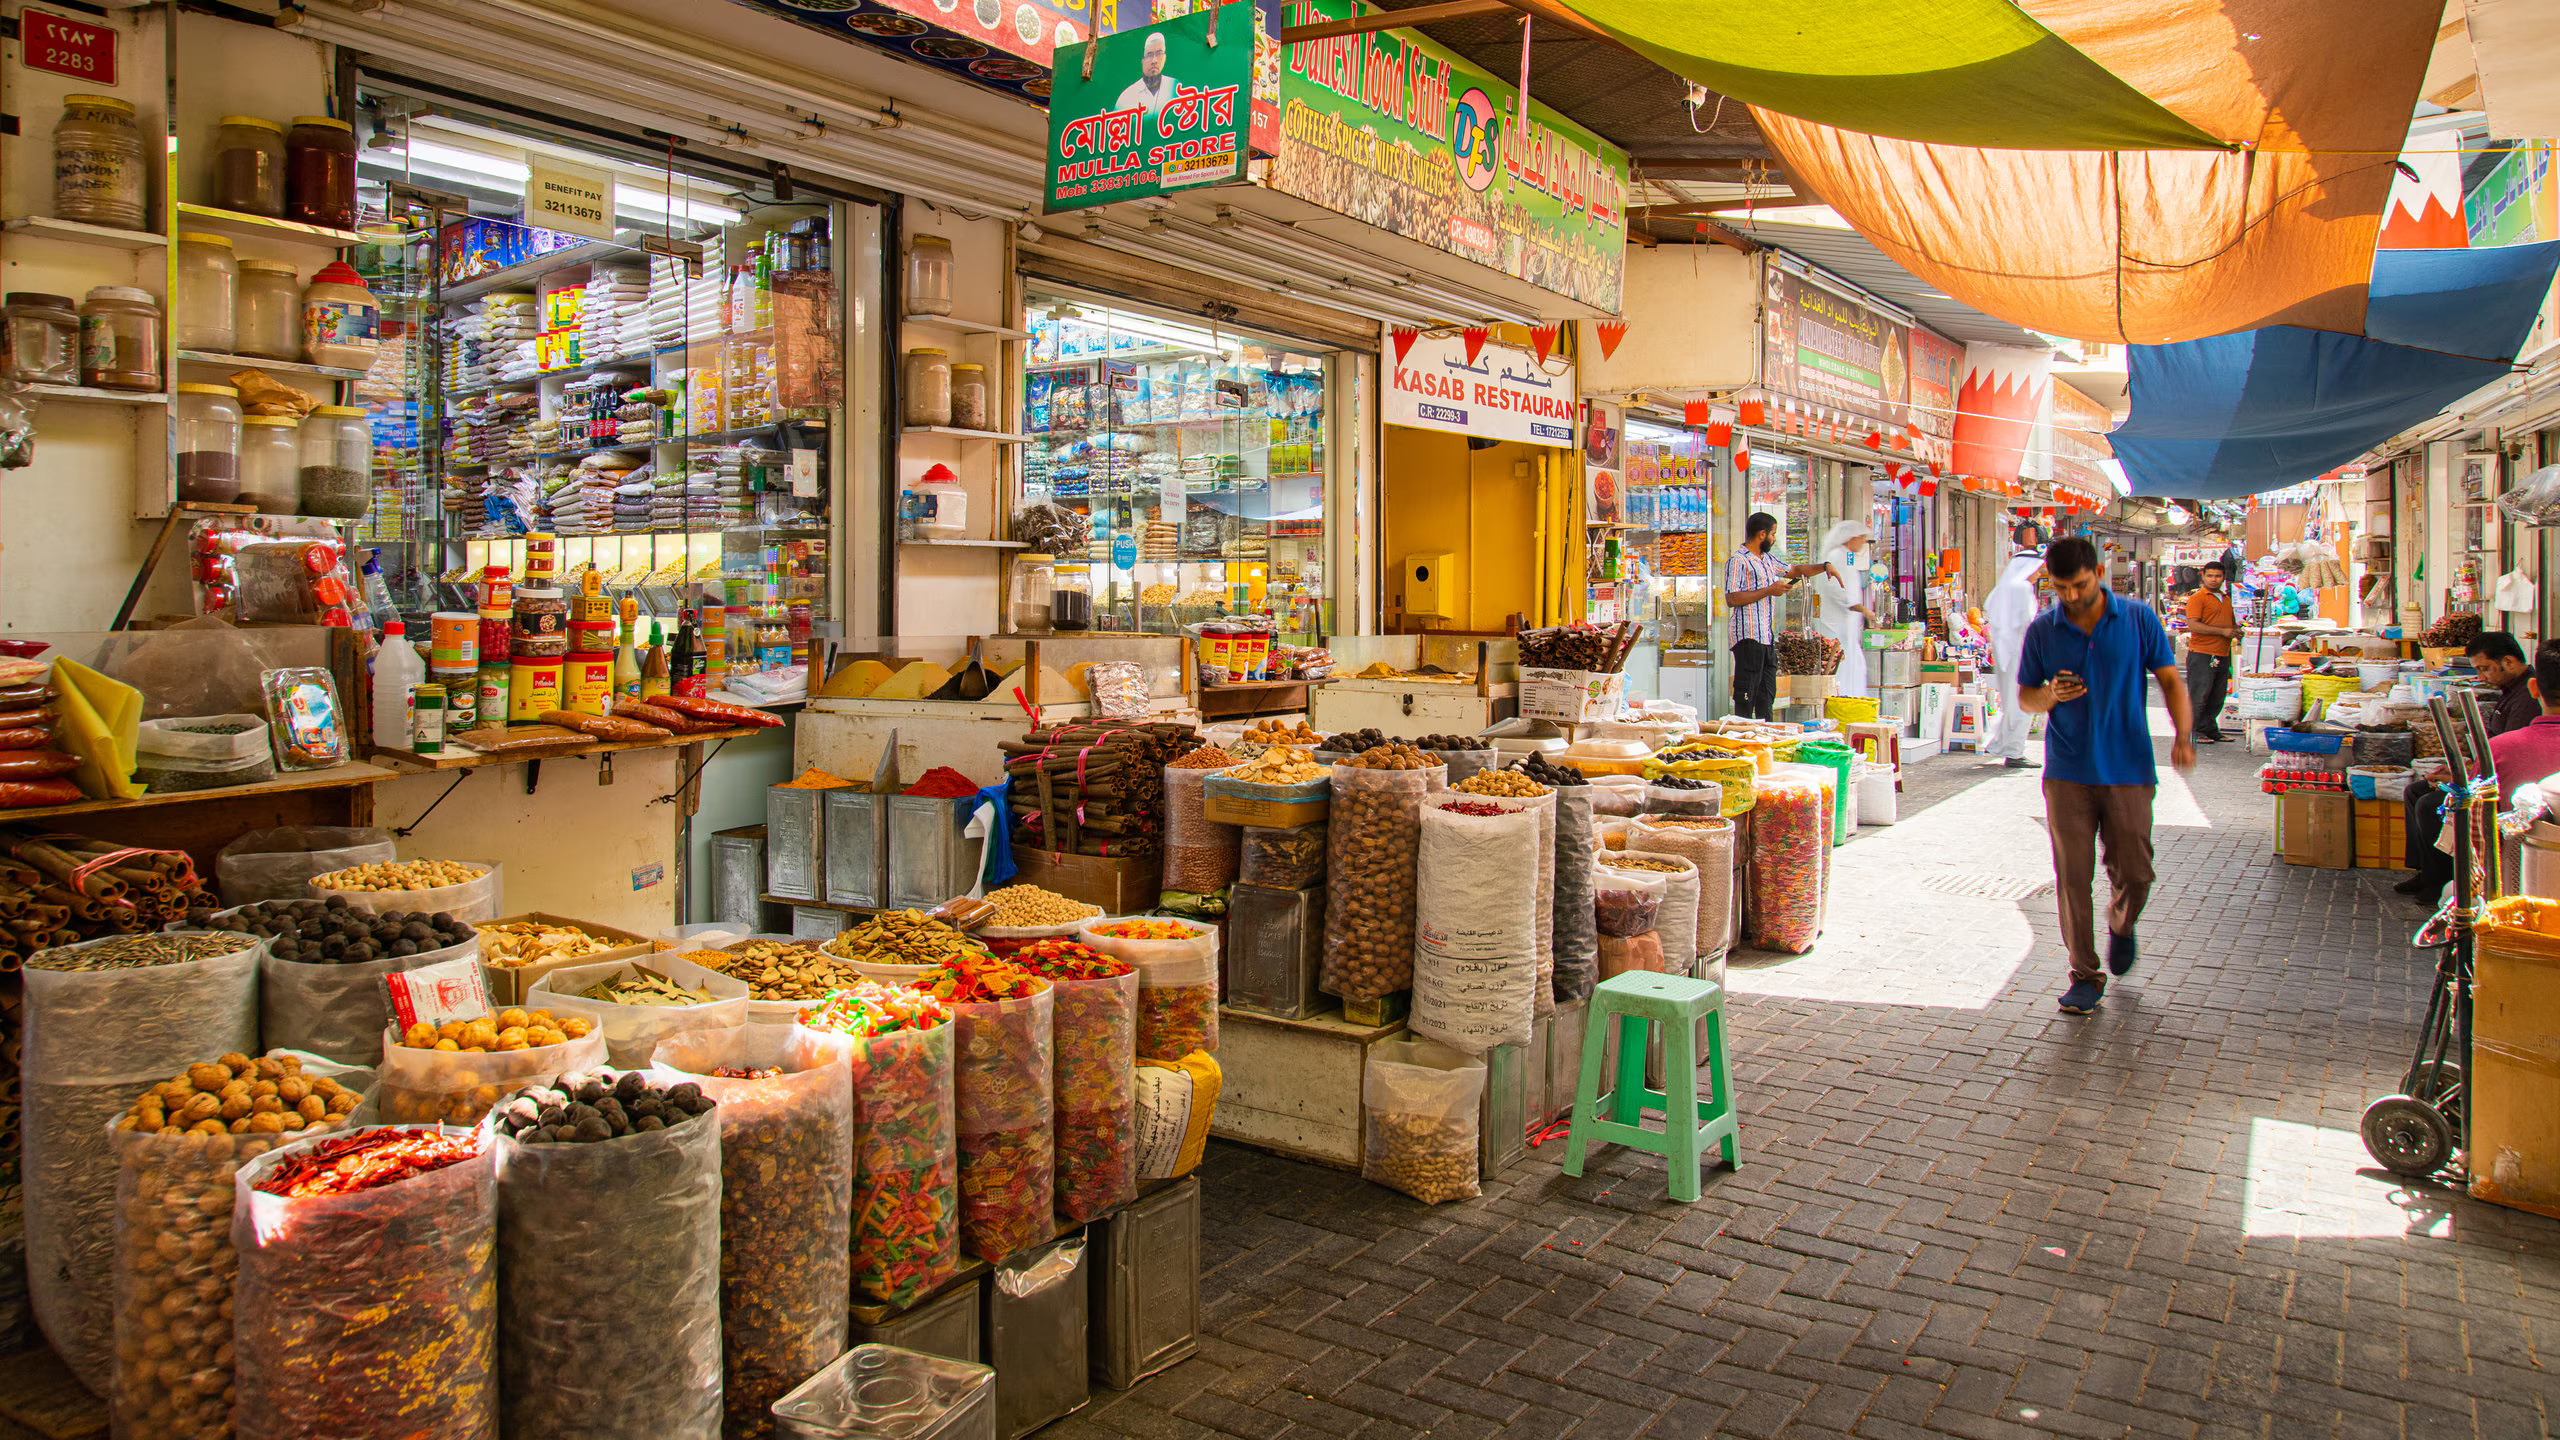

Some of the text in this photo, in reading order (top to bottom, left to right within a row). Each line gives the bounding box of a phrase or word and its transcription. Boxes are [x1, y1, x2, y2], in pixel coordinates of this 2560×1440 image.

[47, 23, 95, 47] ٢٢٨٣
[46, 48, 95, 72] 2283
[1362, 30, 1406, 123] Food
[1407, 43, 1451, 144] Stuff
[1252, 109, 1269, 129] 157
[1057, 132, 1237, 184] MULLA STORE
[1285, 100, 1445, 199] COFFEES, SPICES, NUTS & SWEETS
[1184, 154, 1229, 172] 32113679
[544, 181, 603, 201] BENEFIT PAY
[1056, 169, 1161, 200] Mob: 33831106,
[544, 200, 602, 221] 32113679
[1451, 218, 1464, 241] CR:
[1500, 362, 1552, 388] مطعم
[1393, 366, 1587, 423] KASAB RESTAURANT
[1436, 407, 1461, 422] 22299-3
[1533, 424, 1545, 436] TEL:
[1115, 539, 1134, 549] PUSH
[1431, 977, 1444, 988] KG
